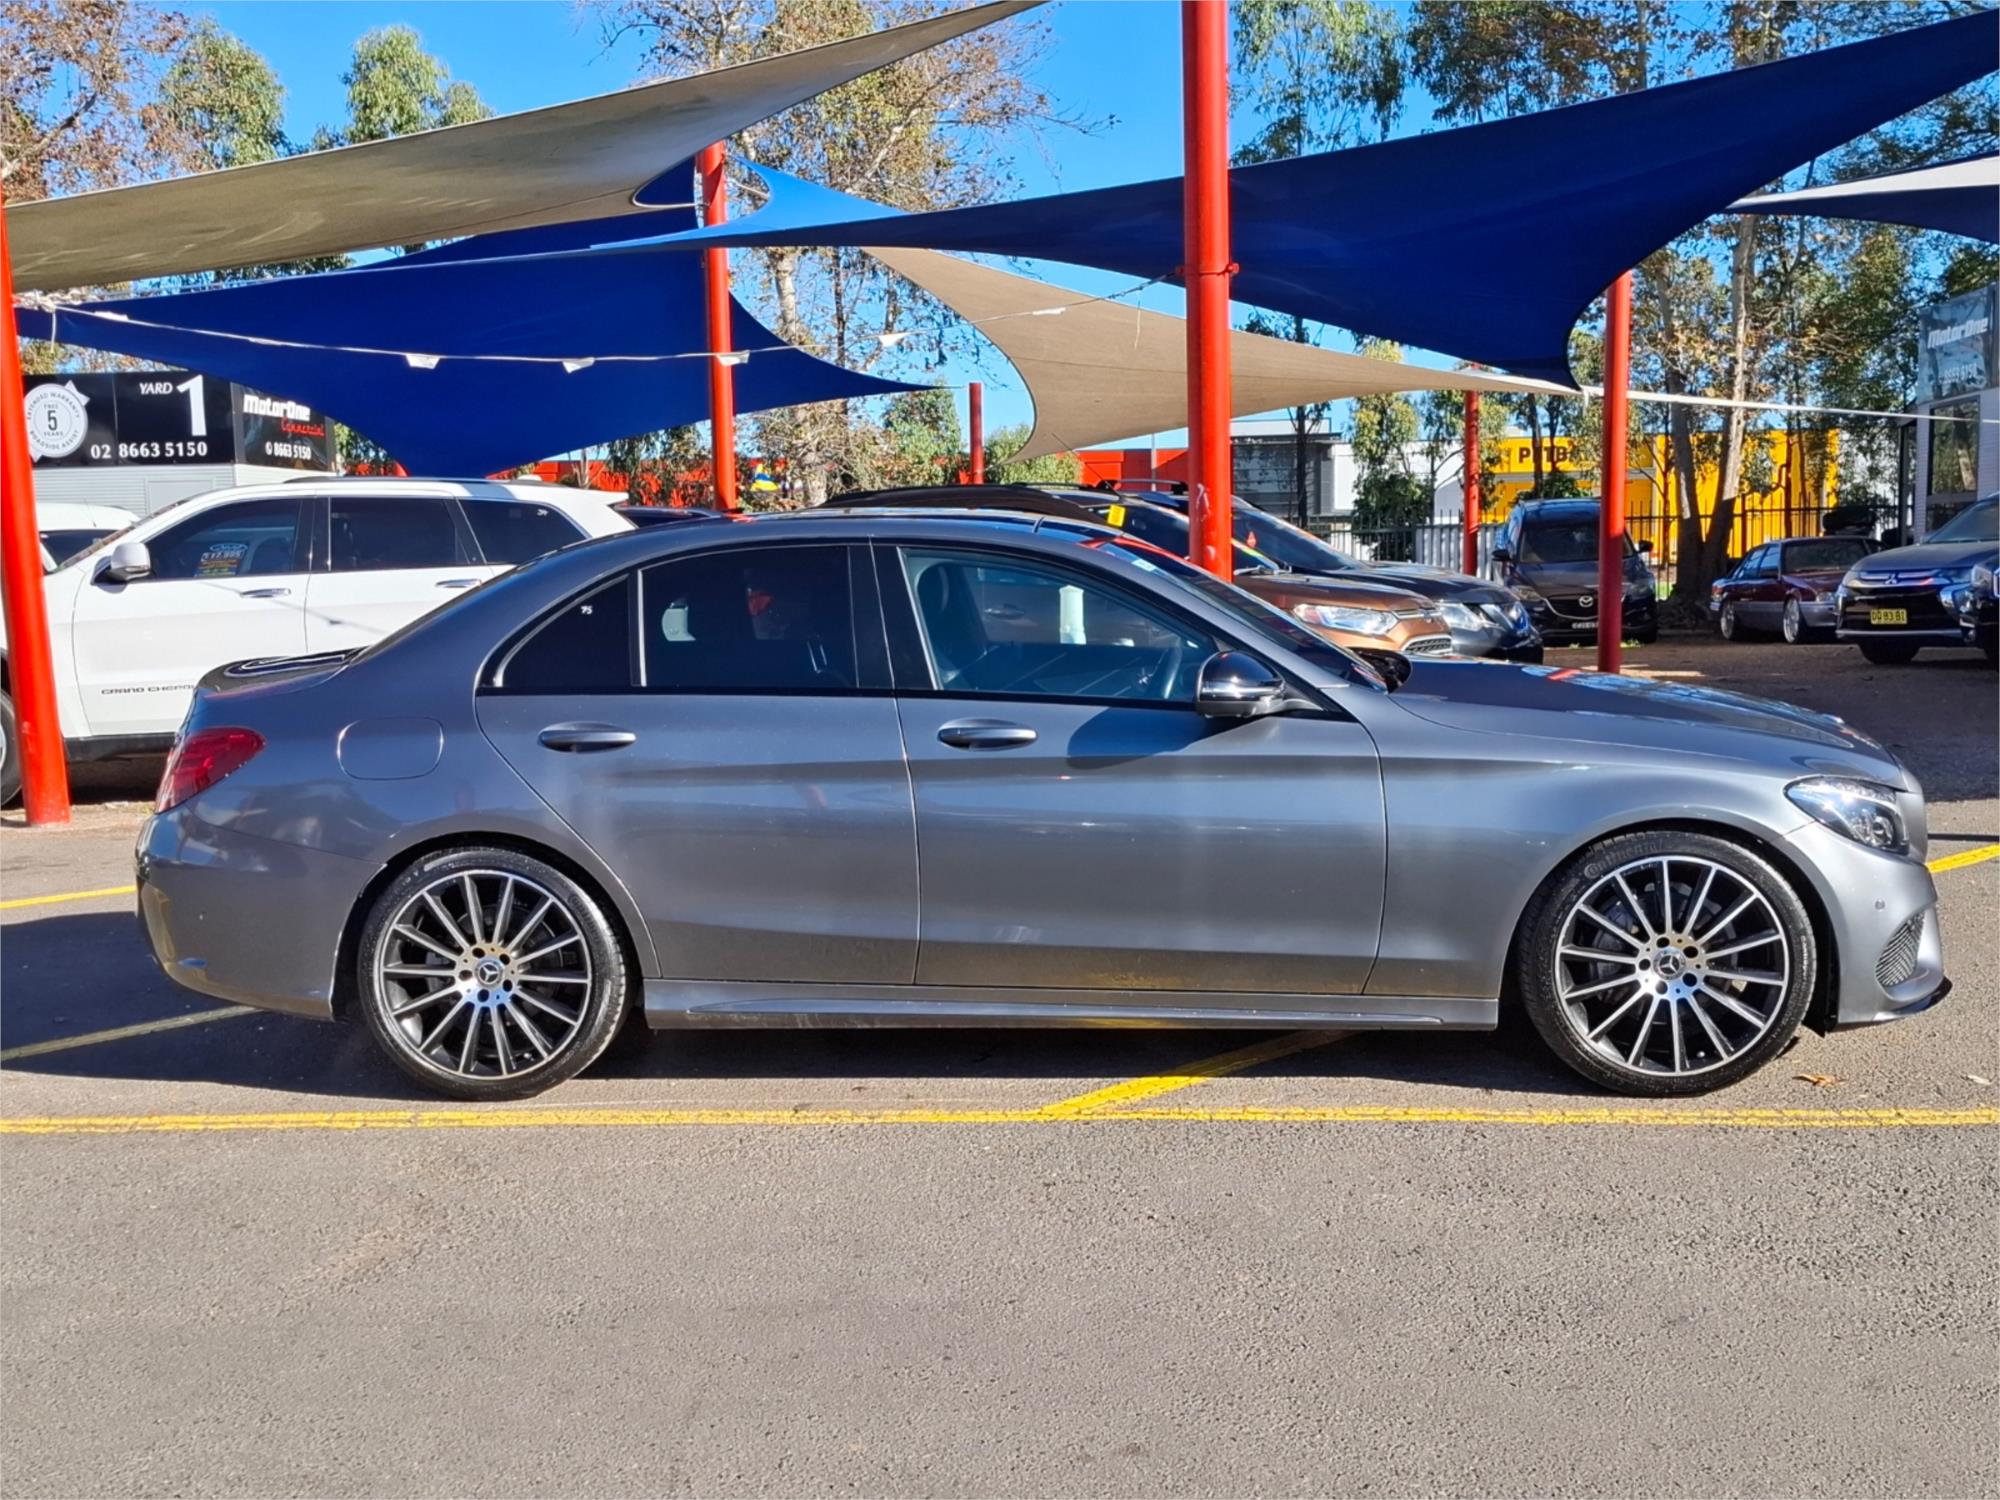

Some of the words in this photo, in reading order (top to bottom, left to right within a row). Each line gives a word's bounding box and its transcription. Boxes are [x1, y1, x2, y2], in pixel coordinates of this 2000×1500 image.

[139, 382, 173, 394] YARD
[176, 374, 207, 436] 1
[47, 409, 58, 431] 5
[90, 444, 112, 459] 02
[118, 442, 161, 458] 8663
[164, 441, 208, 457] 5150
[273, 441, 292, 458] 8663
[293, 444, 312, 460] 5150
[101, 687, 145, 695] GRAND
